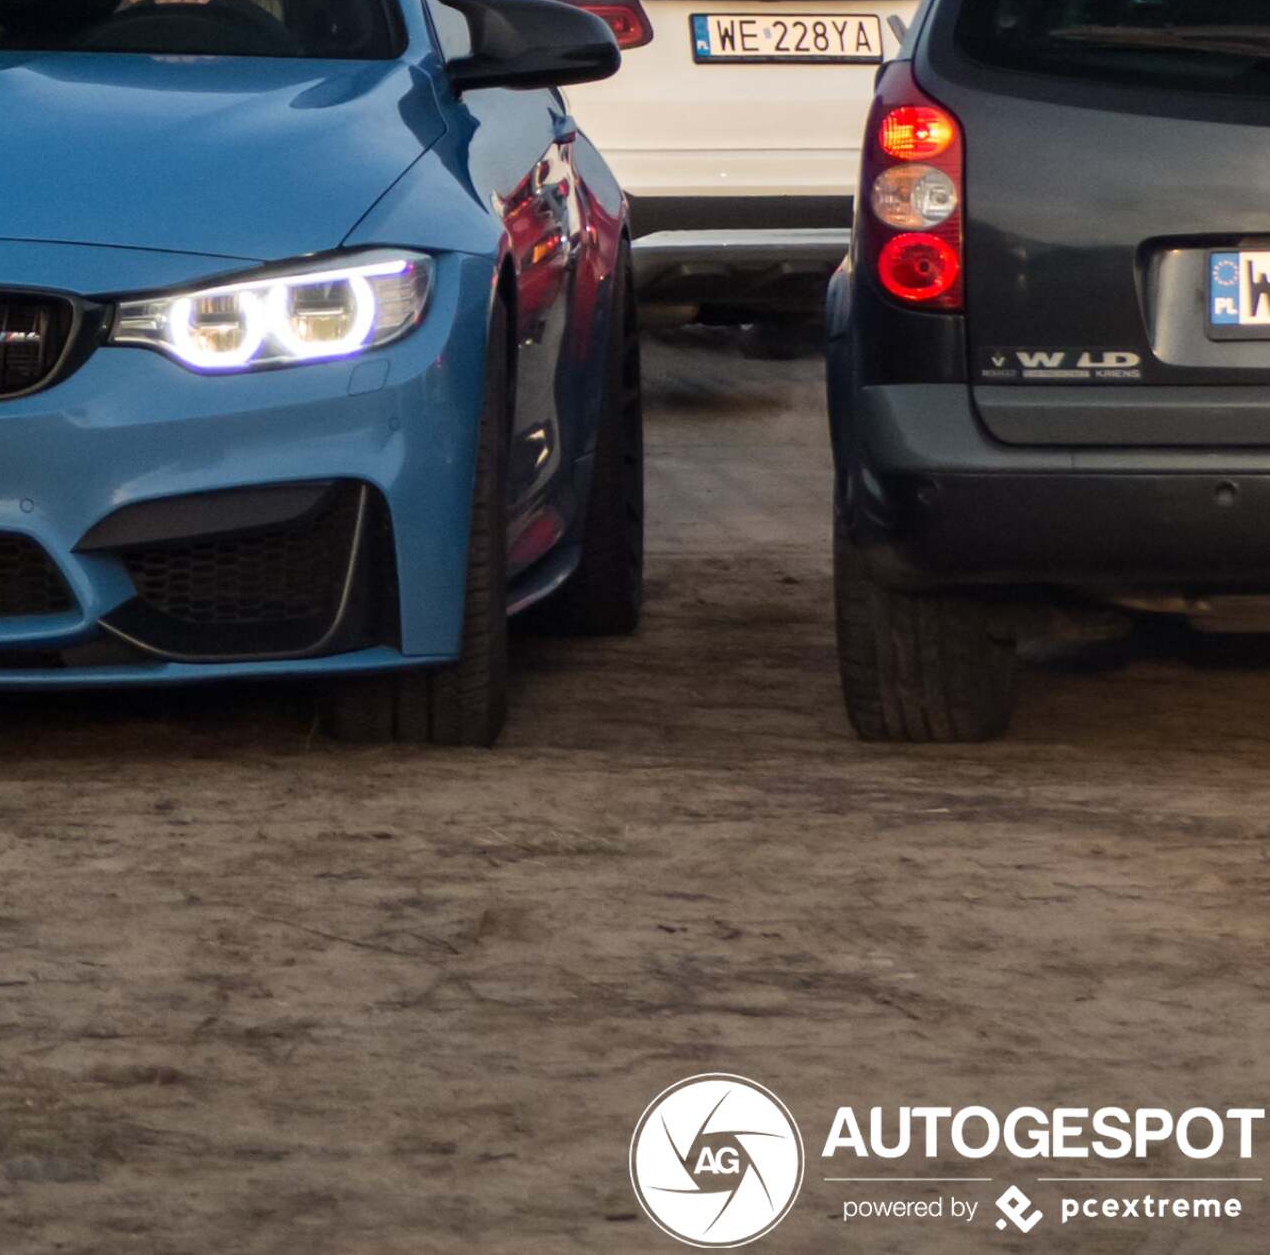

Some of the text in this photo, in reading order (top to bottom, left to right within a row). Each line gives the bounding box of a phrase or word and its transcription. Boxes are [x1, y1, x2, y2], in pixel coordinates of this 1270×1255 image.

[716, 20, 872, 53] WE 228YA
[1214, 296, 1237, 316] PL
